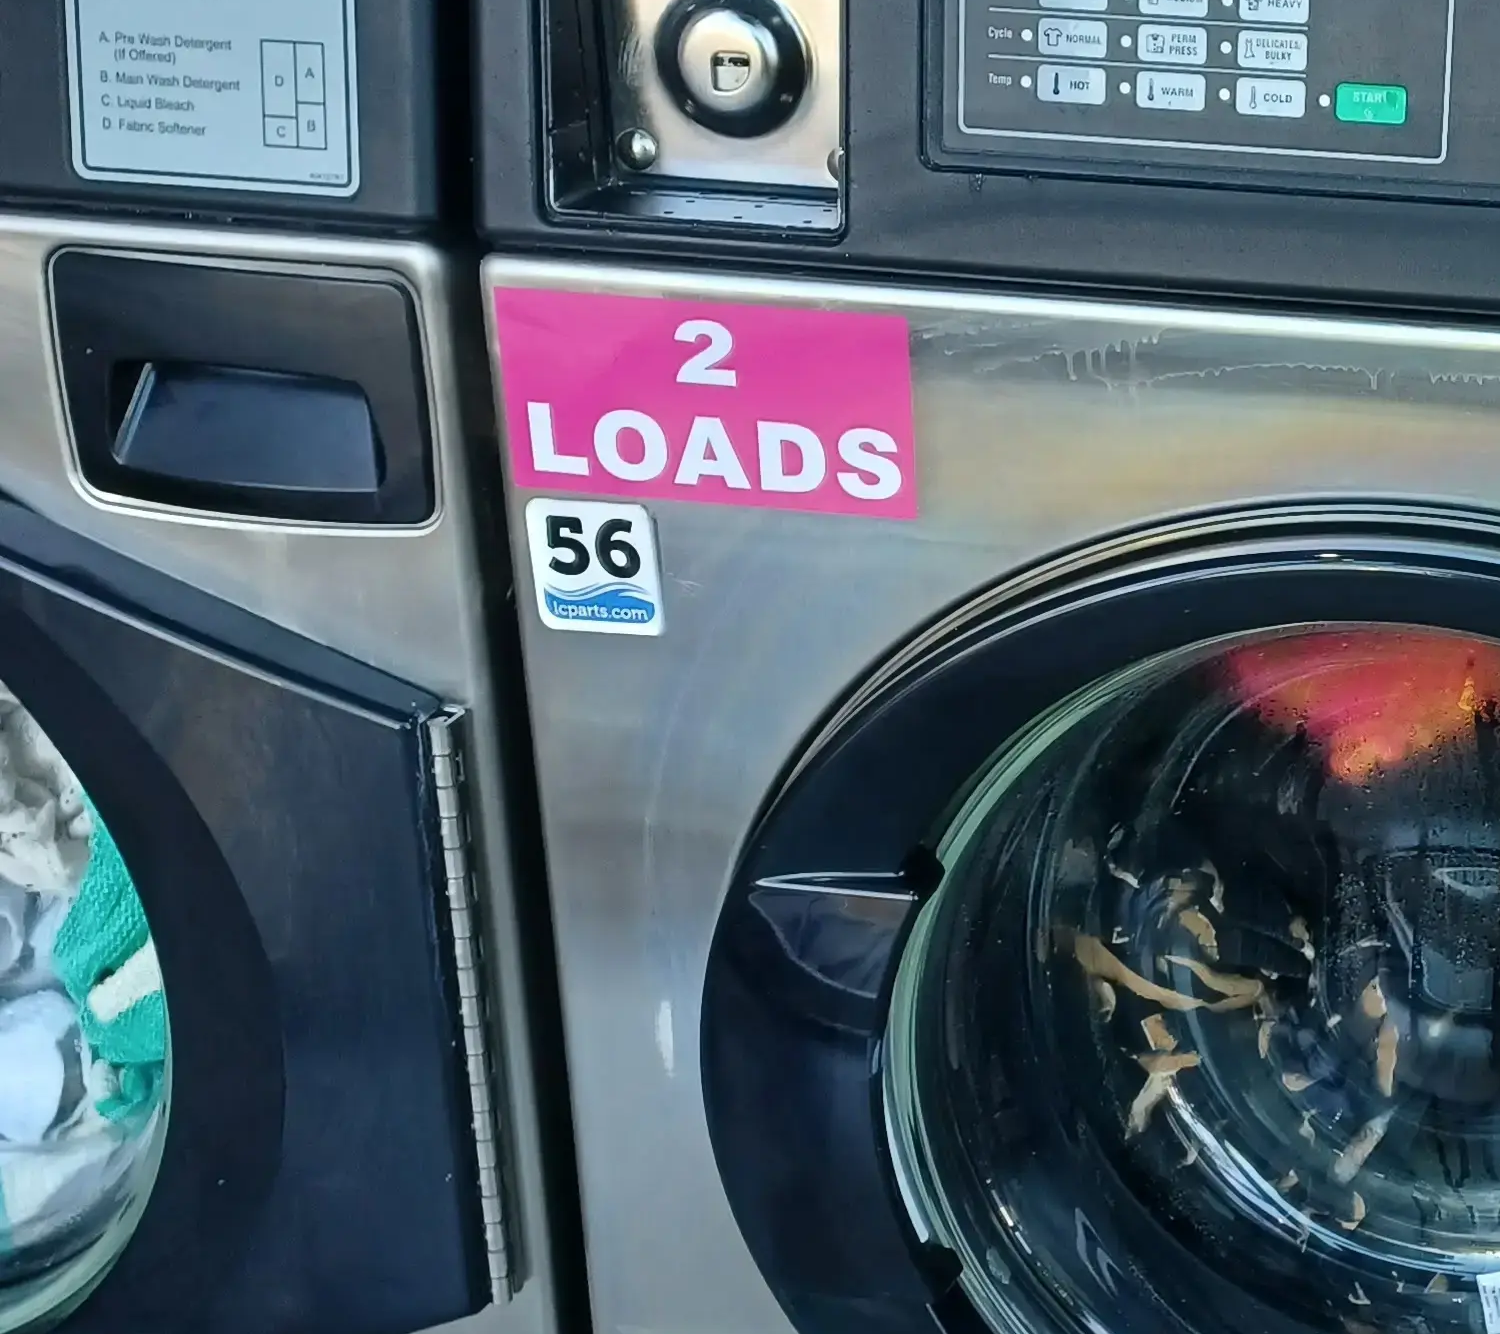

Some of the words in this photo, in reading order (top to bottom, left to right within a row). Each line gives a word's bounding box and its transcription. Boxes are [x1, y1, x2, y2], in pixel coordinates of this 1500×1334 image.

[988, 26, 1012, 38] Cycle
[1066, 34, 1102, 44] NORMAL
[1171, 33, 1197, 44] PERM
[1169, 46, 1198, 55] PRESS
[1265, 51, 1292, 60] BULKY
[988, 73, 1012, 85] Temp
[1070, 81, 1090, 90] HOT
[1161, 87, 1193, 97] WARM
[1264, 93, 1292, 103] COLD
[673, 319, 737, 388] 2
[527, 400, 903, 500] LOADS
[546, 514, 641, 578] 56
